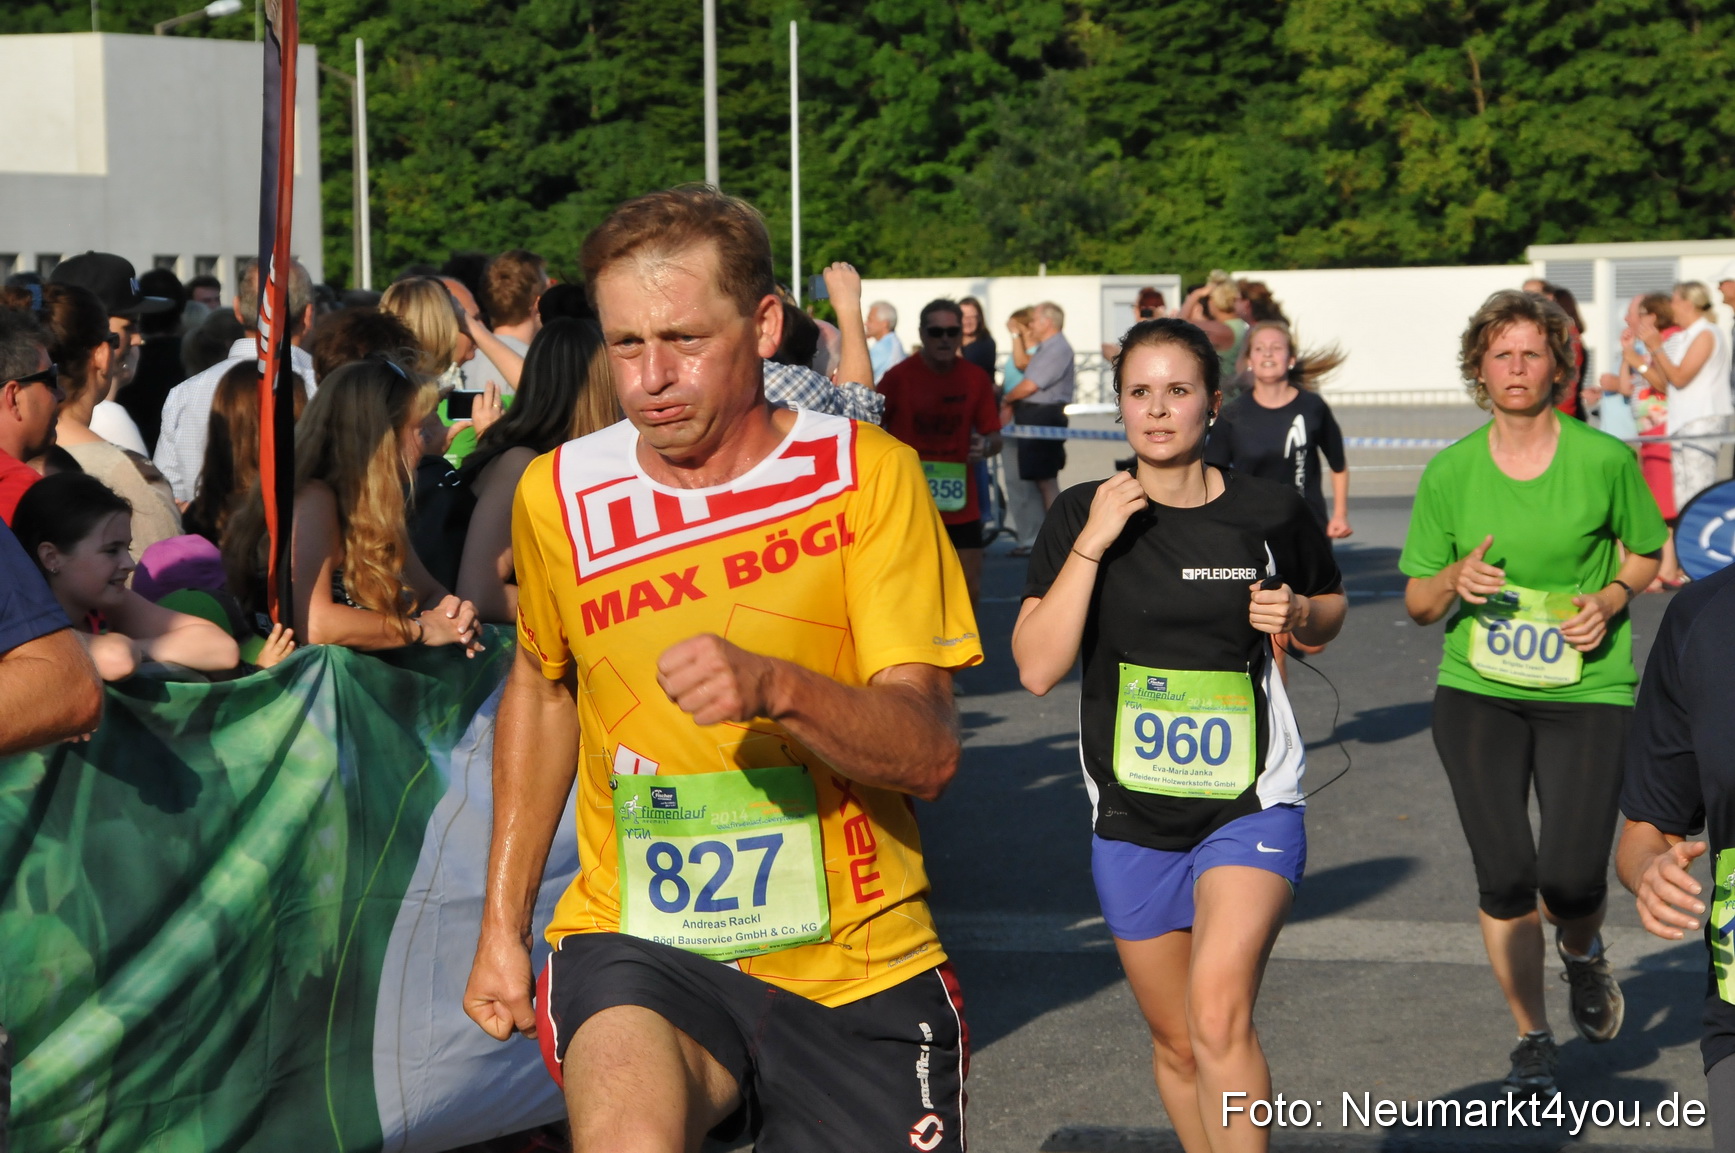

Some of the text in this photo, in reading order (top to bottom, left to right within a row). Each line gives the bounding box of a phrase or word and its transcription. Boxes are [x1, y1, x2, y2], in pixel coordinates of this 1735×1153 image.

[580, 566, 707, 637] MAX
[722, 512, 856, 589] BÖGL
[1194, 568, 1257, 580] PFLEIDERER
[1487, 619, 1565, 664] 600
[1138, 688, 1187, 701] firmenlauf
[1134, 712, 1232, 766] 960
[1152, 765, 1188, 776] Eva-Maria
[1129, 772, 1236, 788] Pfleiderer Holzwerkstoffe GmbH
[641, 805, 707, 820] firmenlauf
[711, 809, 748, 825] 2014
[646, 833, 784, 914] 827
[682, 913, 761, 929] Andreas Rackl
[678, 934, 733, 945] Bauservice
[735, 929, 768, 941] GmbH
[770, 928, 778, 937] &
[781, 926, 799, 935] Co.
[801, 922, 818, 933] KG
[916, 1051, 935, 1109] pacific
